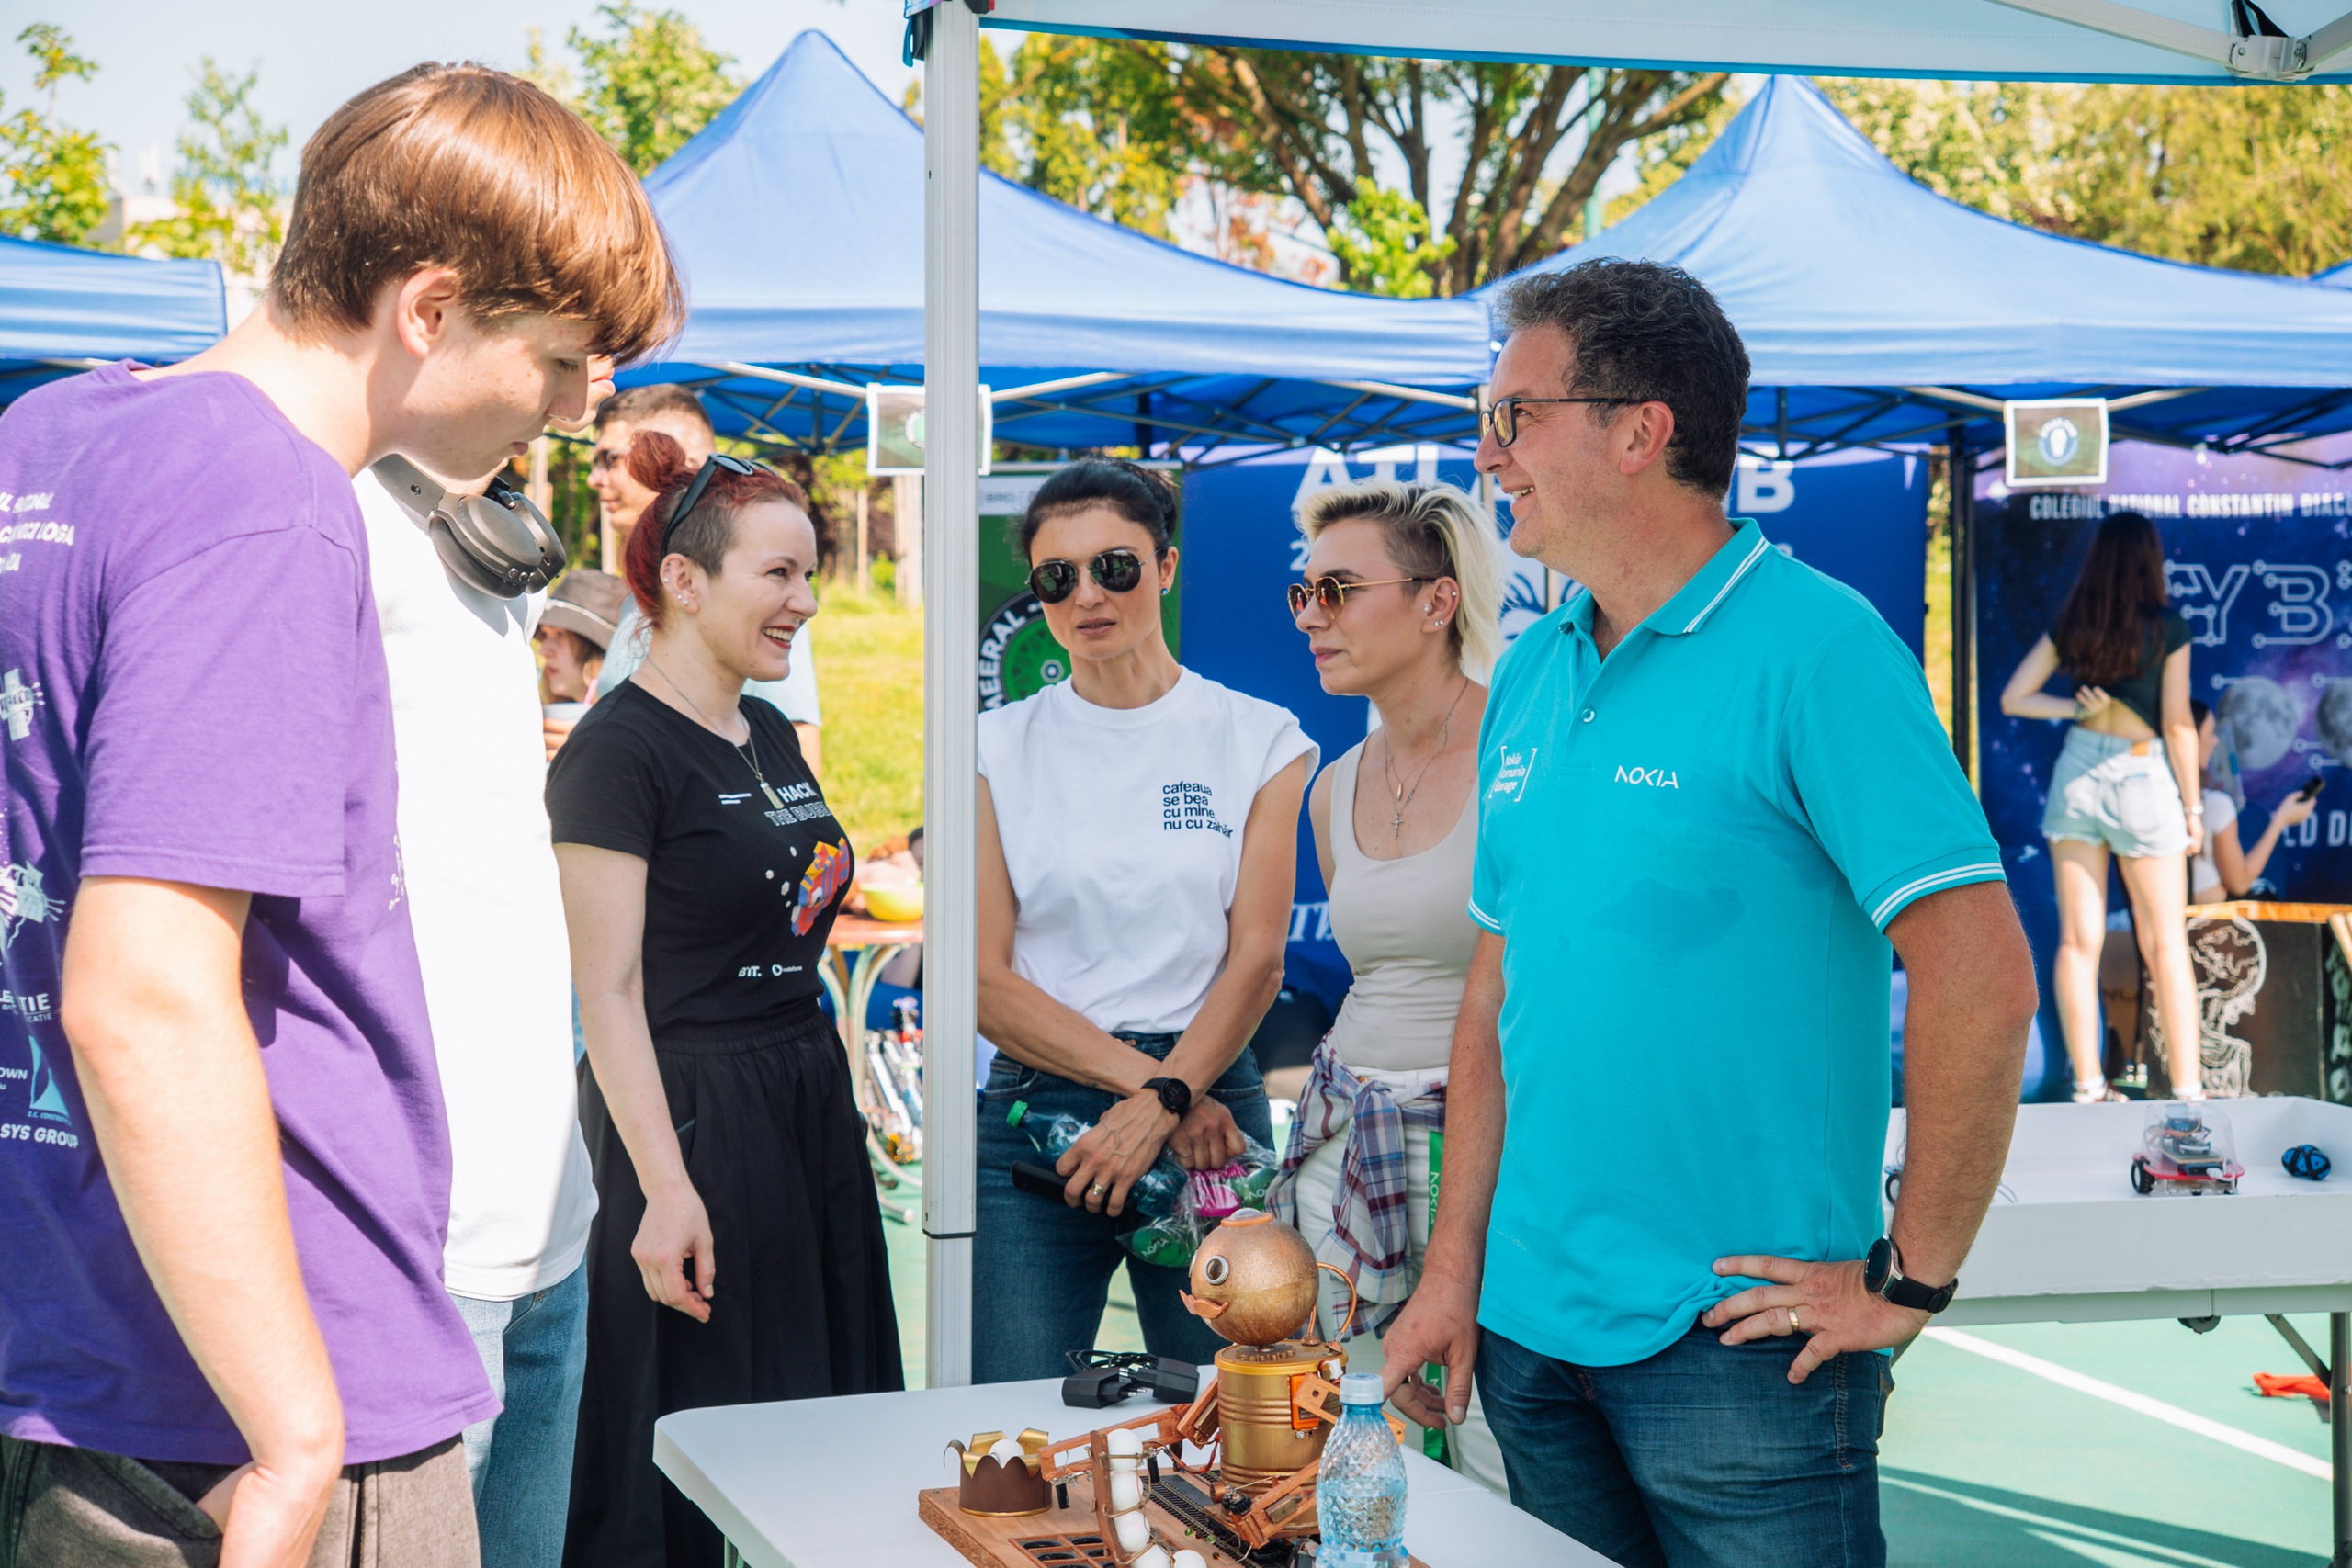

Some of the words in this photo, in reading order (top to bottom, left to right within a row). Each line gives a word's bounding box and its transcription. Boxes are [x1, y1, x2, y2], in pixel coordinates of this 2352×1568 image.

[2187, 492, 2294, 519] CONSTANTIN
[1614, 764, 1679, 789] NOKIA
[776, 782, 819, 803] HACK
[1162, 781, 1213, 796] cafeaua
[1163, 795, 1180, 807] se
[1183, 792, 1209, 806] bea
[763, 808, 798, 827] THE
[1163, 808, 1181, 818] cu
[1163, 820, 1182, 830] nu
[1185, 819, 1203, 829] cu
[34, 1127, 79, 1149] GROUP
